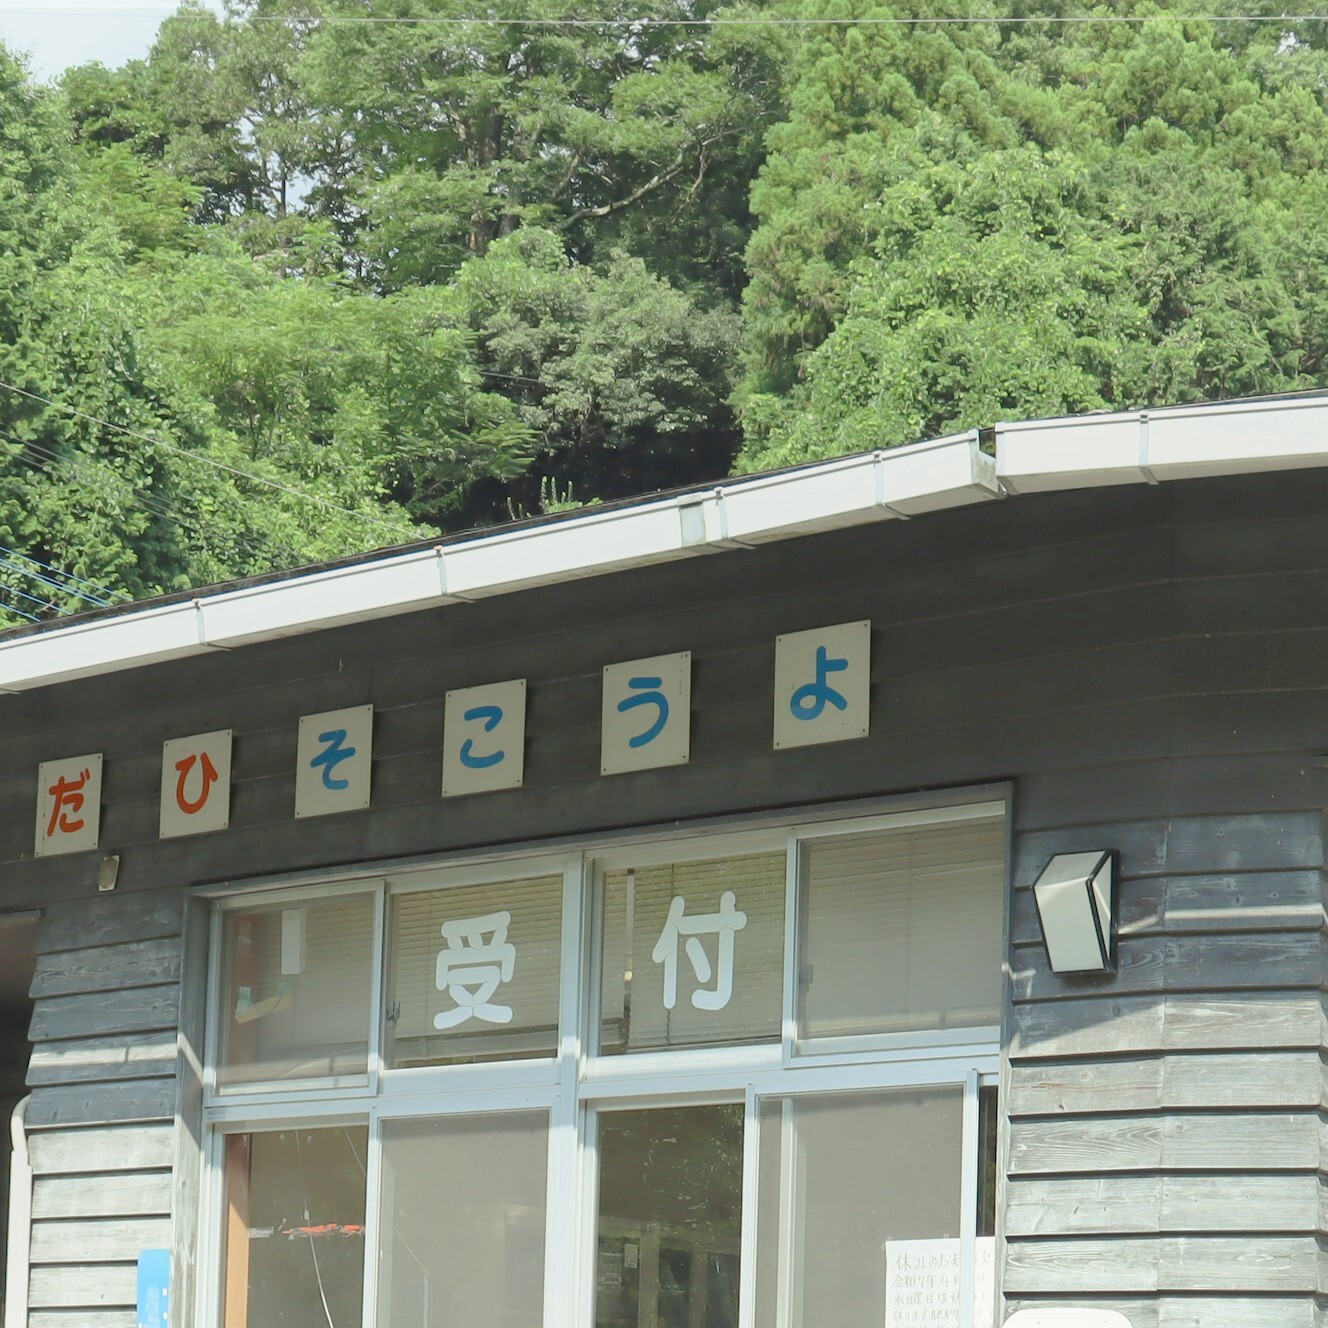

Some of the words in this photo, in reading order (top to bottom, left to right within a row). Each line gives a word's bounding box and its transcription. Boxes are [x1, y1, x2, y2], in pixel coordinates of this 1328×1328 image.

[433, 890, 747, 1030] 受付
[895, 1250, 994, 1271] 休みのおせ
[892, 1274, 985, 1289] 令和7年4り
